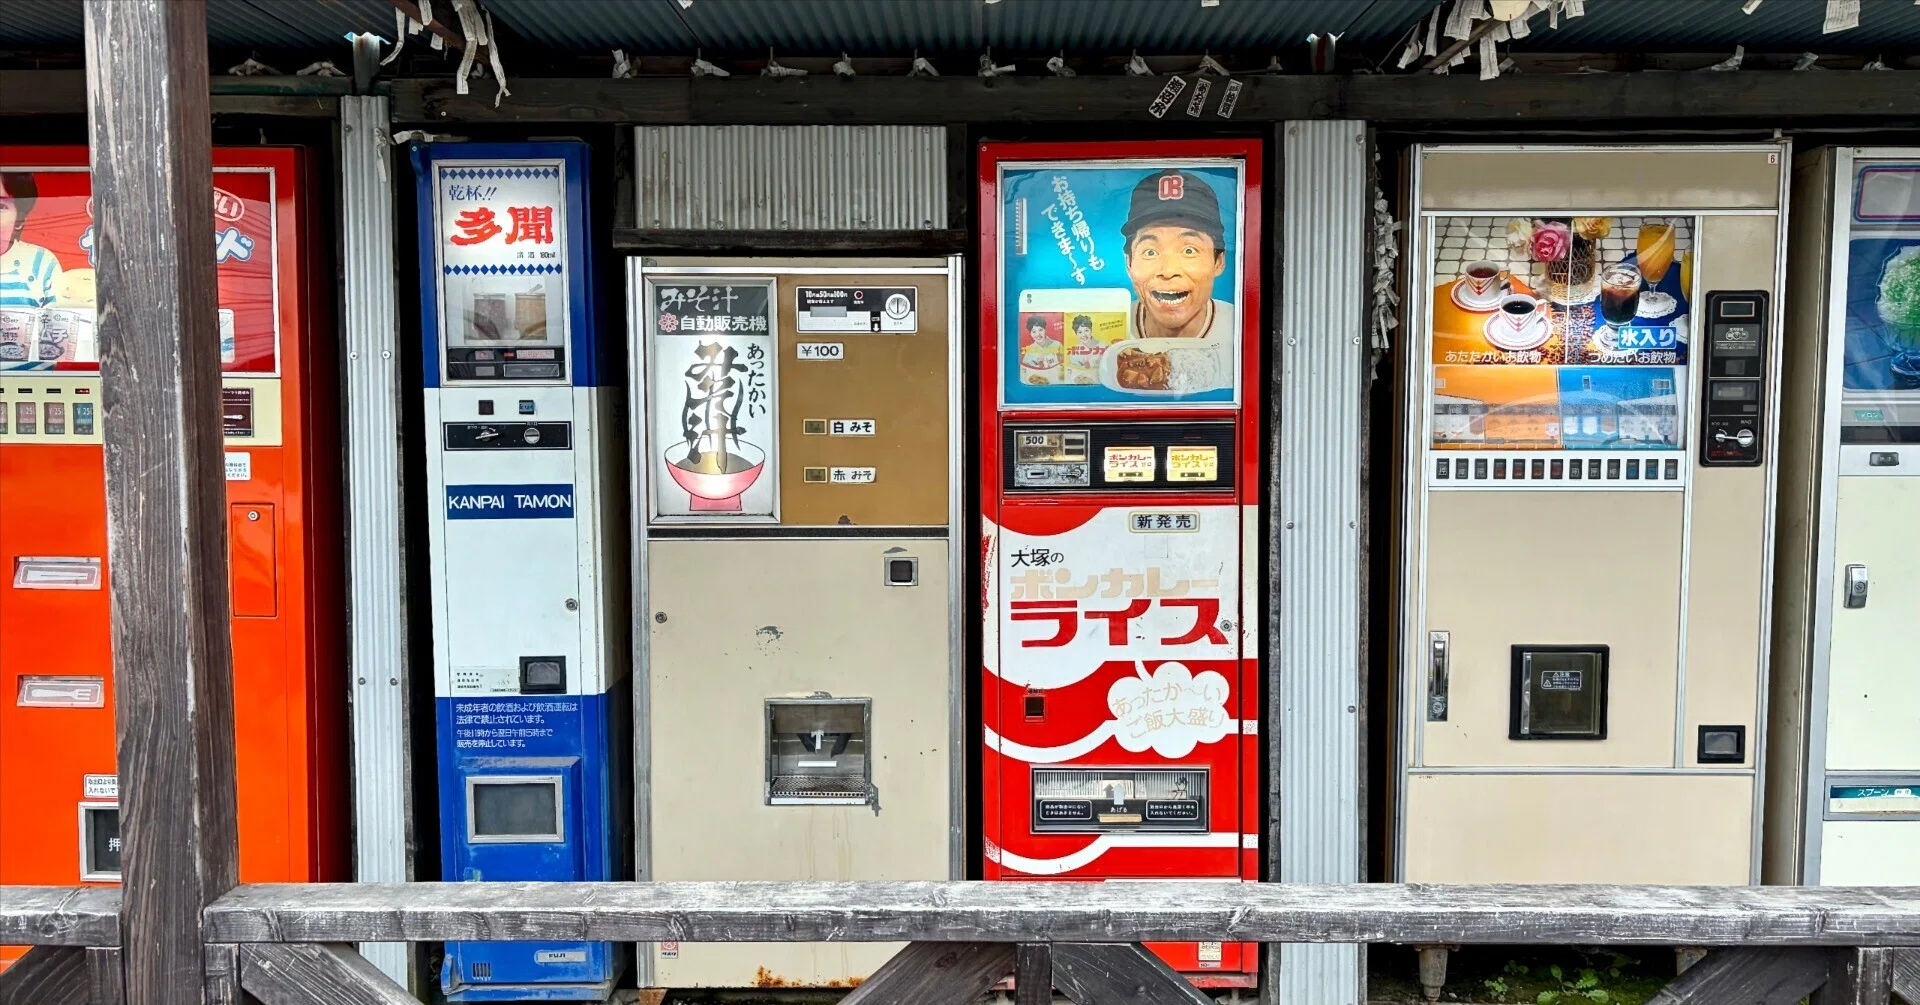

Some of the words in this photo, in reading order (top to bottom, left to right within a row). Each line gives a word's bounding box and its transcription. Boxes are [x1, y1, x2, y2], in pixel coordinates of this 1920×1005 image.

[1770, 154, 1776, 164] 6
[450, 206, 554, 246] 多聞
[1051, 175, 1105, 271] お持ち帰りも
[660, 285, 738, 313] みそ汁
[680, 315, 768, 332] 自動販売機
[1620, 329, 1676, 346] 氷入り
[802, 345, 840, 357] ¥100
[1066, 345, 1110, 356] ボンカ
[1445, 350, 1541, 364] あたたかいお飲物
[1589, 350, 1677, 364] つめたいお飲物
[747, 342, 767, 419] あったかい
[833, 421, 844, 433] 白
[850, 422, 872, 433] みそ
[1025, 436, 1044, 445] 500
[833, 469, 846, 481] 赤
[449, 495, 505, 509] KANPAI
[514, 494, 572, 509] TAMON
[1136, 514, 1192, 529] 新発売
[1010, 548, 1064, 567] 大塚の
[1010, 567, 1219, 599] ボンカレー
[1010, 598, 1229, 648] ライス
[455, 702, 579, 713] 未成年者の飲酒および飲酒運転は
[456, 714, 545, 725] 法律で禁止されています。
[1127, 707, 1225, 739] ご飯大盛り
[456, 728, 554, 738] 午後11時から翌日午前5時まで
[456, 739, 526, 748] 販売を停止しています。
